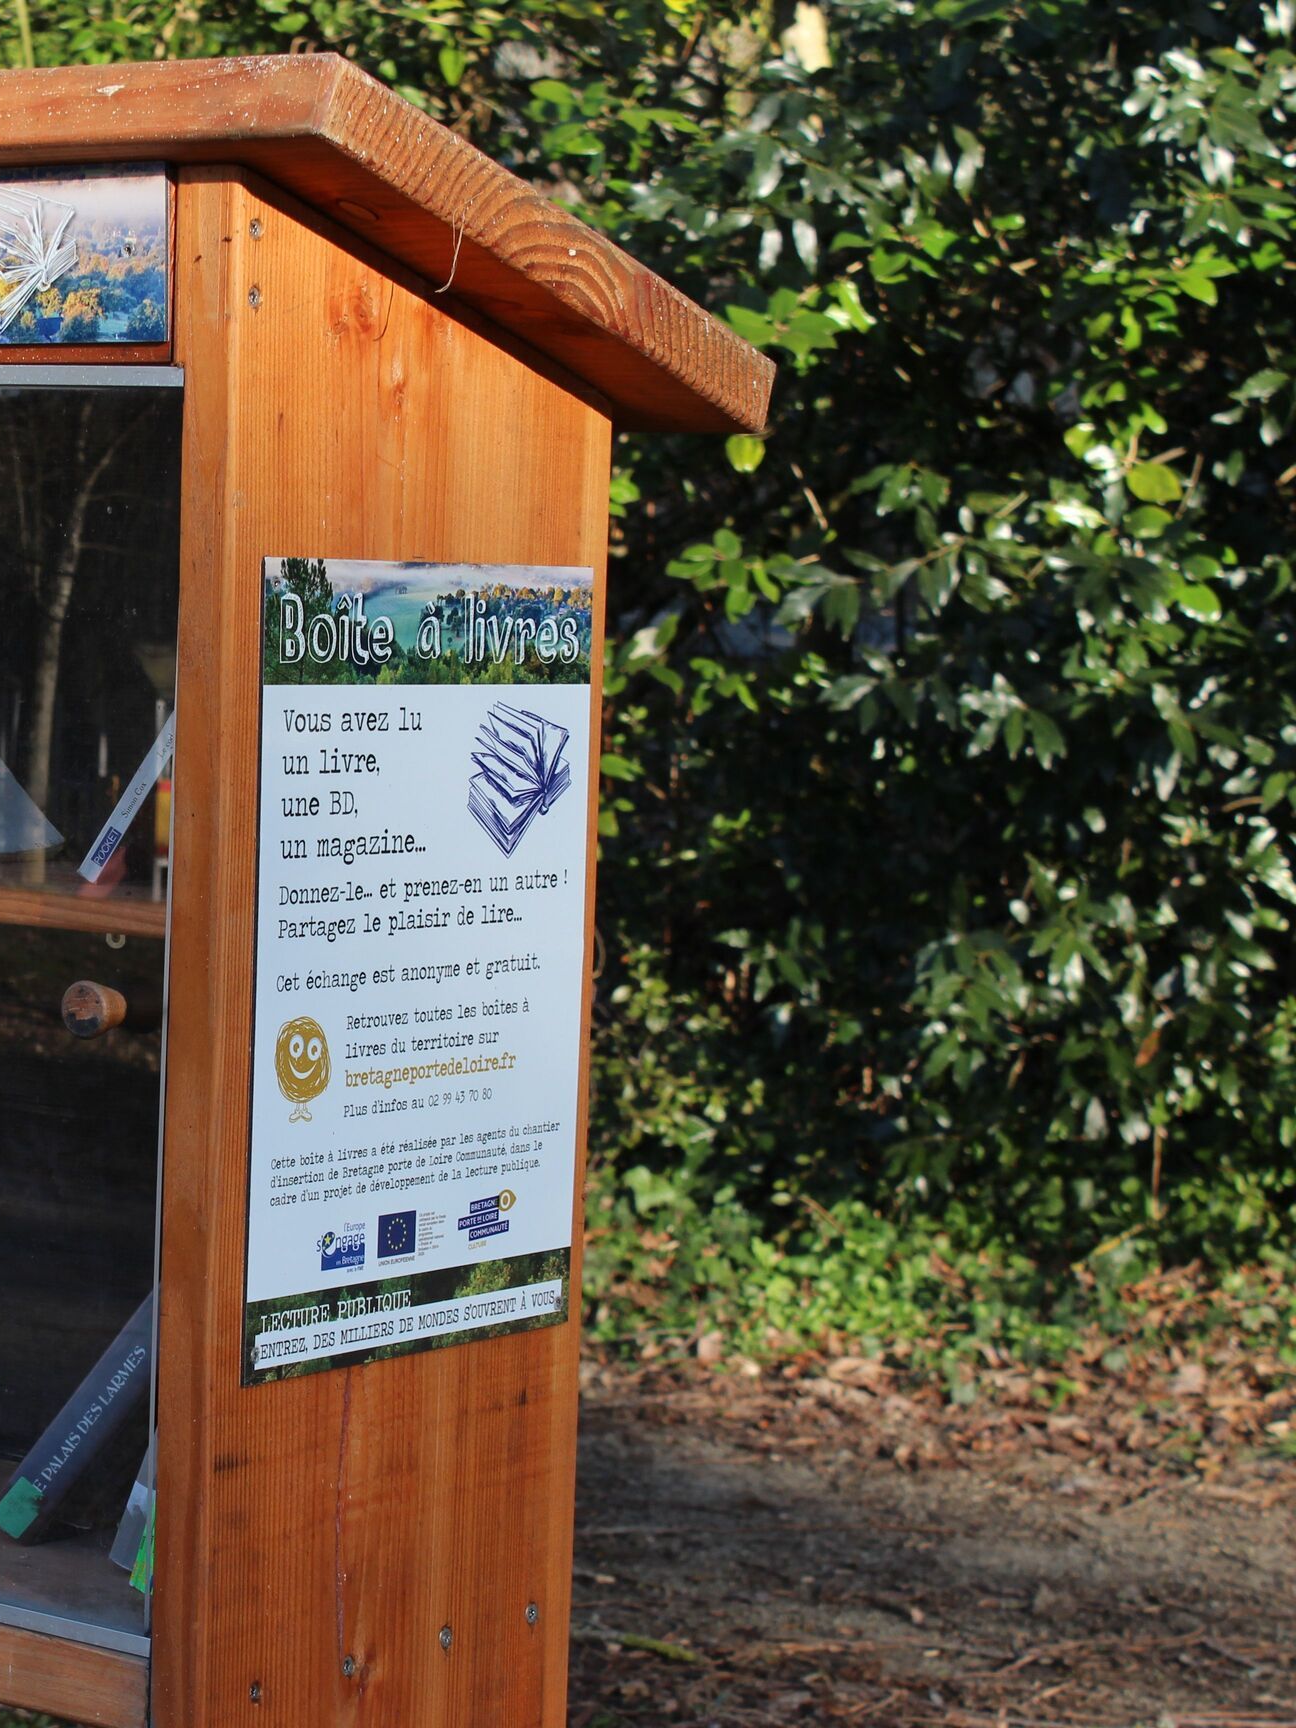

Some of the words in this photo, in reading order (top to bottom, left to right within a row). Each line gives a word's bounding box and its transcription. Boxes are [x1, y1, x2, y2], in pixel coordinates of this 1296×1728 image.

[279, 592, 394, 665] Boîte
[417, 601, 443, 659] à
[464, 593, 581, 665] livres
[283, 708, 332, 733] Vous
[341, 710, 389, 732] avez
[398, 706, 423, 732] lu
[282, 754, 309, 775] un
[319, 748, 381, 776] livre,
[121, 797, 138, 819] Simon
[134, 781, 148, 798] Cox
[282, 795, 320, 817] une
[329, 791, 359, 818] BD,
[93, 827, 121, 866] POCKET
[281, 838, 308, 859] un
[379, 878, 397, 898] et
[403, 878, 483, 902] prenez-en
[489, 874, 509, 892] un
[515, 869, 558, 891] autre
[278, 915, 356, 942] Partagez
[363, 913, 381, 933] le
[388, 907, 451, 936] plaisir
[457, 905, 474, 926] de
[276, 972, 300, 993] Cet
[306, 970, 367, 992] échange
[372, 964, 396, 984] est
[401, 963, 460, 984] anonyme
[466, 958, 480, 976] et
[485, 953, 541, 980] gratuit.
[346, 1012, 409, 1031] Retrouvez
[414, 1005, 453, 1023] toutes
[457, 1004, 477, 1019] les
[482, 999, 518, 1016] boîtes
[522, 997, 530, 1013] à
[345, 1042, 386, 1059] livres
[391, 1038, 406, 1055] du
[411, 1031, 474, 1052] territoire
[478, 1031, 500, 1044] sur
[345, 1052, 517, 1089] bretagneportedeloire.fr
[344, 1104, 368, 1118] Plus
[371, 1098, 408, 1115] d'infos
[412, 1098, 424, 1110] au
[428, 1094, 439, 1107] 02
[442, 1092, 452, 1105] 99
[455, 1090, 465, 1104] 43
[469, 1089, 479, 1102] 70
[482, 1088, 492, 1100] 80
[271, 1156, 295, 1170] Cette
[300, 1152, 324, 1166] boîte
[327, 1150, 334, 1162] à
[337, 1147, 368, 1161] livres
[371, 1146, 377, 1156] a
[380, 1142, 395, 1155] été
[398, 1136, 437, 1153] réalisée
[440, 1135, 456, 1149] par
[459, 1133, 474, 1145] les
[477, 1129, 506, 1145] agents
[509, 1126, 520, 1137] du
[522, 1121, 561, 1135] chantier
[270, 1170, 324, 1189] d'insertion
[328, 1168, 339, 1181] de
[342, 1164, 385, 1179] Bretagne
[387, 1158, 413, 1175] porte
[415, 1156, 426, 1168] de
[429, 1152, 453, 1166] Loire
[510, 1142, 530, 1155] dans
[533, 1140, 543, 1151] le
[270, 1191, 297, 1207] cadre
[300, 1189, 320, 1202] d'un
[323, 1185, 353, 1201] projet
[355, 1182, 367, 1195] de
[369, 1172, 435, 1190] développement
[438, 1170, 448, 1182] de
[452, 1168, 462, 1180] la
[465, 1163, 498, 1179] lecture
[459, 1218, 477, 1228] PORTE
[482, 1211, 498, 1222] LOIRE
[260, 1337, 308, 1360] ENTREZ,
[313, 1331, 335, 1349] DES
[340, 1320, 394, 1345] MILLIERS
[399, 1316, 414, 1334] DE
[418, 1308, 459, 1330] MONDES
[463, 1297, 516, 1320] S'OUVRENT
[520, 1291, 527, 1310] À
[261, 1303, 330, 1333] LECTURE
[337, 1289, 411, 1319] PUBLIQUE
[41, 1430, 81, 1480] PALAIS
[77, 1402, 103, 1436] DES
[98, 1345, 147, 1408] LARMES
